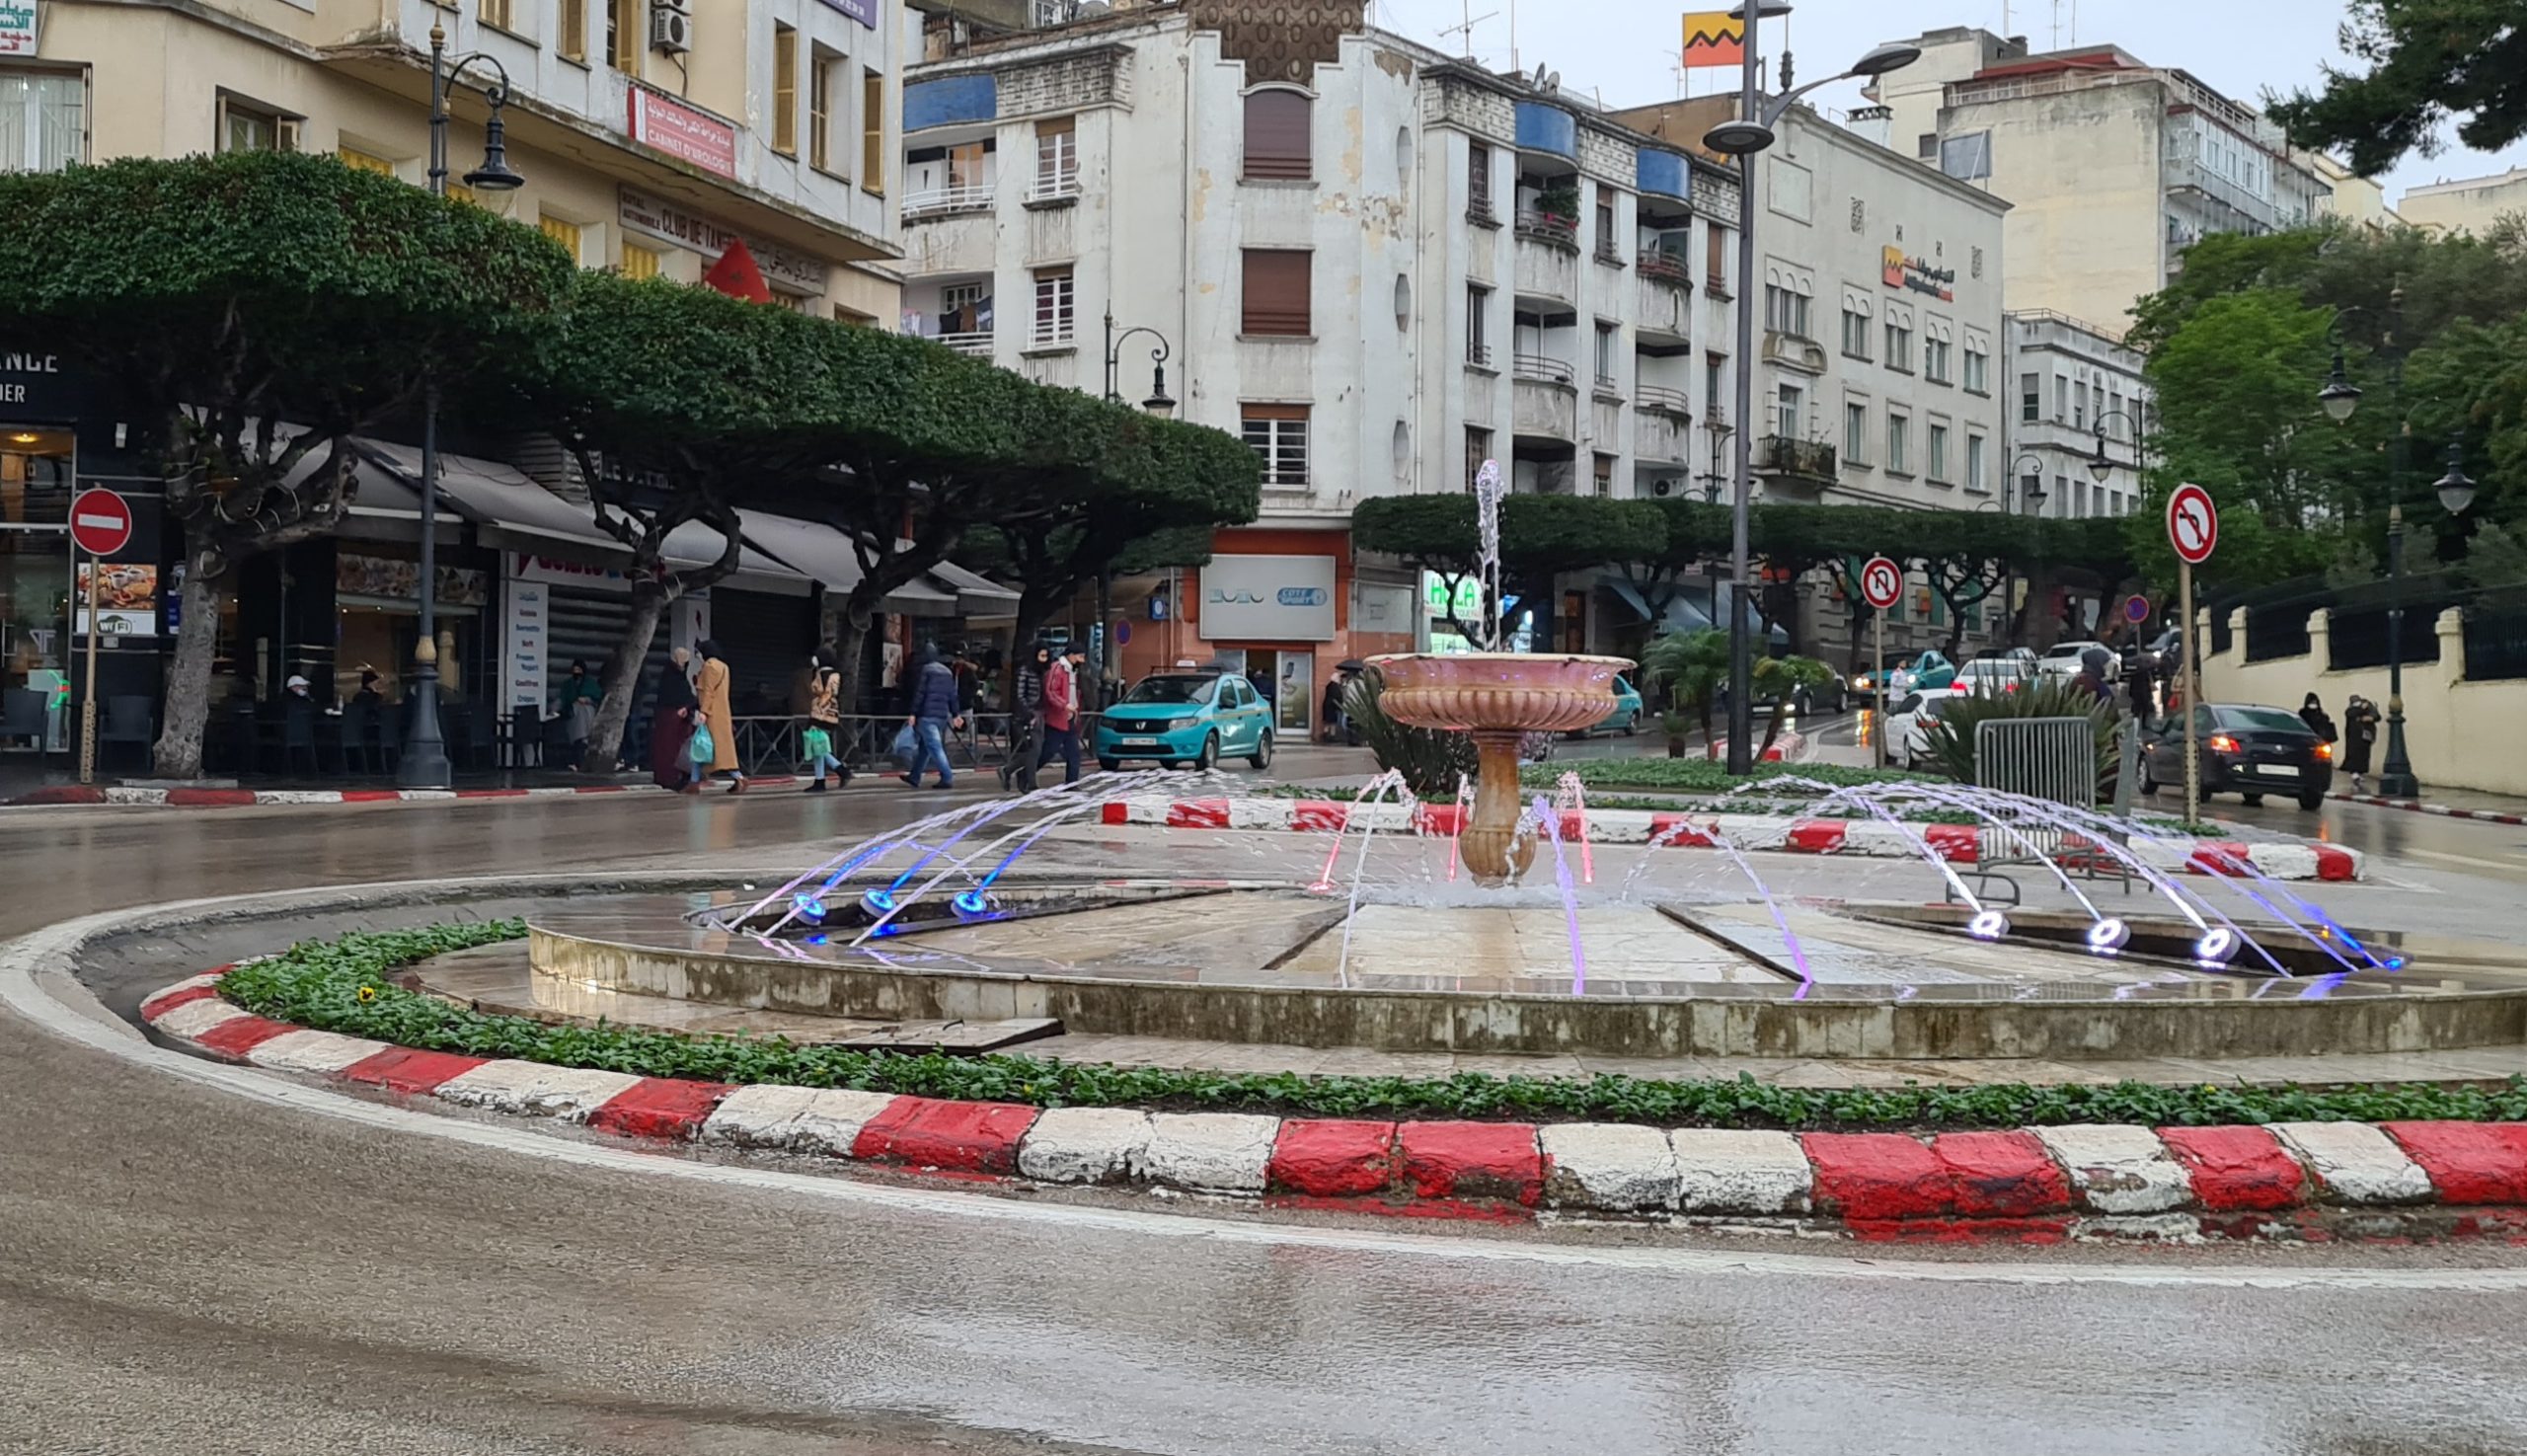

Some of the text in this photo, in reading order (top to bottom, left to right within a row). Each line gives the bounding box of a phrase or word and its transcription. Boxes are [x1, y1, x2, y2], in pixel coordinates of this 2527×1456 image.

[648, 129, 683, 153] CABINET
[662, 208, 687, 239] CLUB
[690, 218, 702, 245] DE
